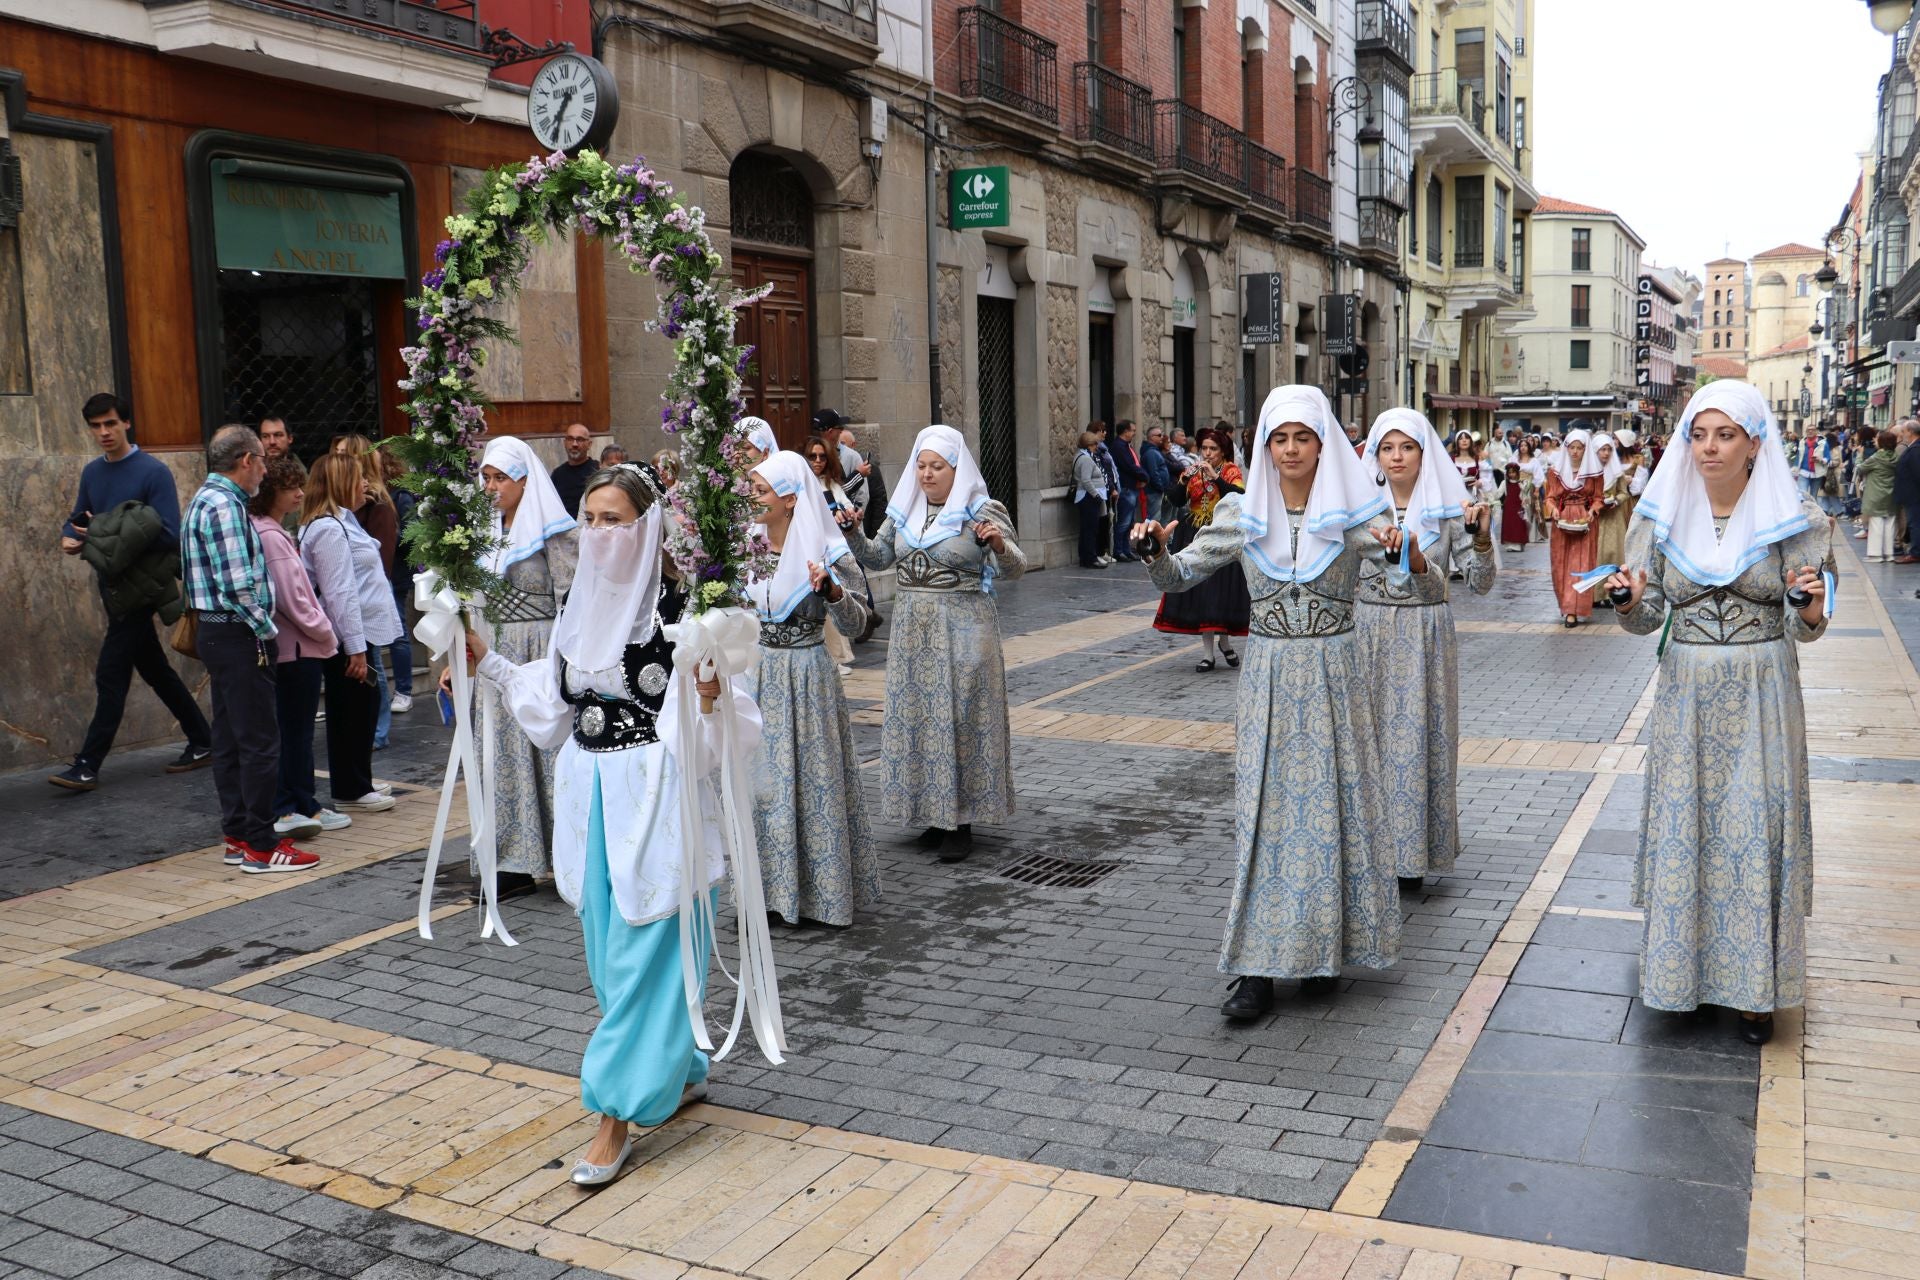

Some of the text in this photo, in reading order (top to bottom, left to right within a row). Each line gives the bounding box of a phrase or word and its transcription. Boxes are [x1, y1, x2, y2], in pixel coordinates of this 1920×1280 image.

[958, 201, 999, 211] Carrefour
[964, 212, 993, 221] express
[316, 219, 389, 244] JOYERIA
[269, 247, 364, 273] ANGEL
